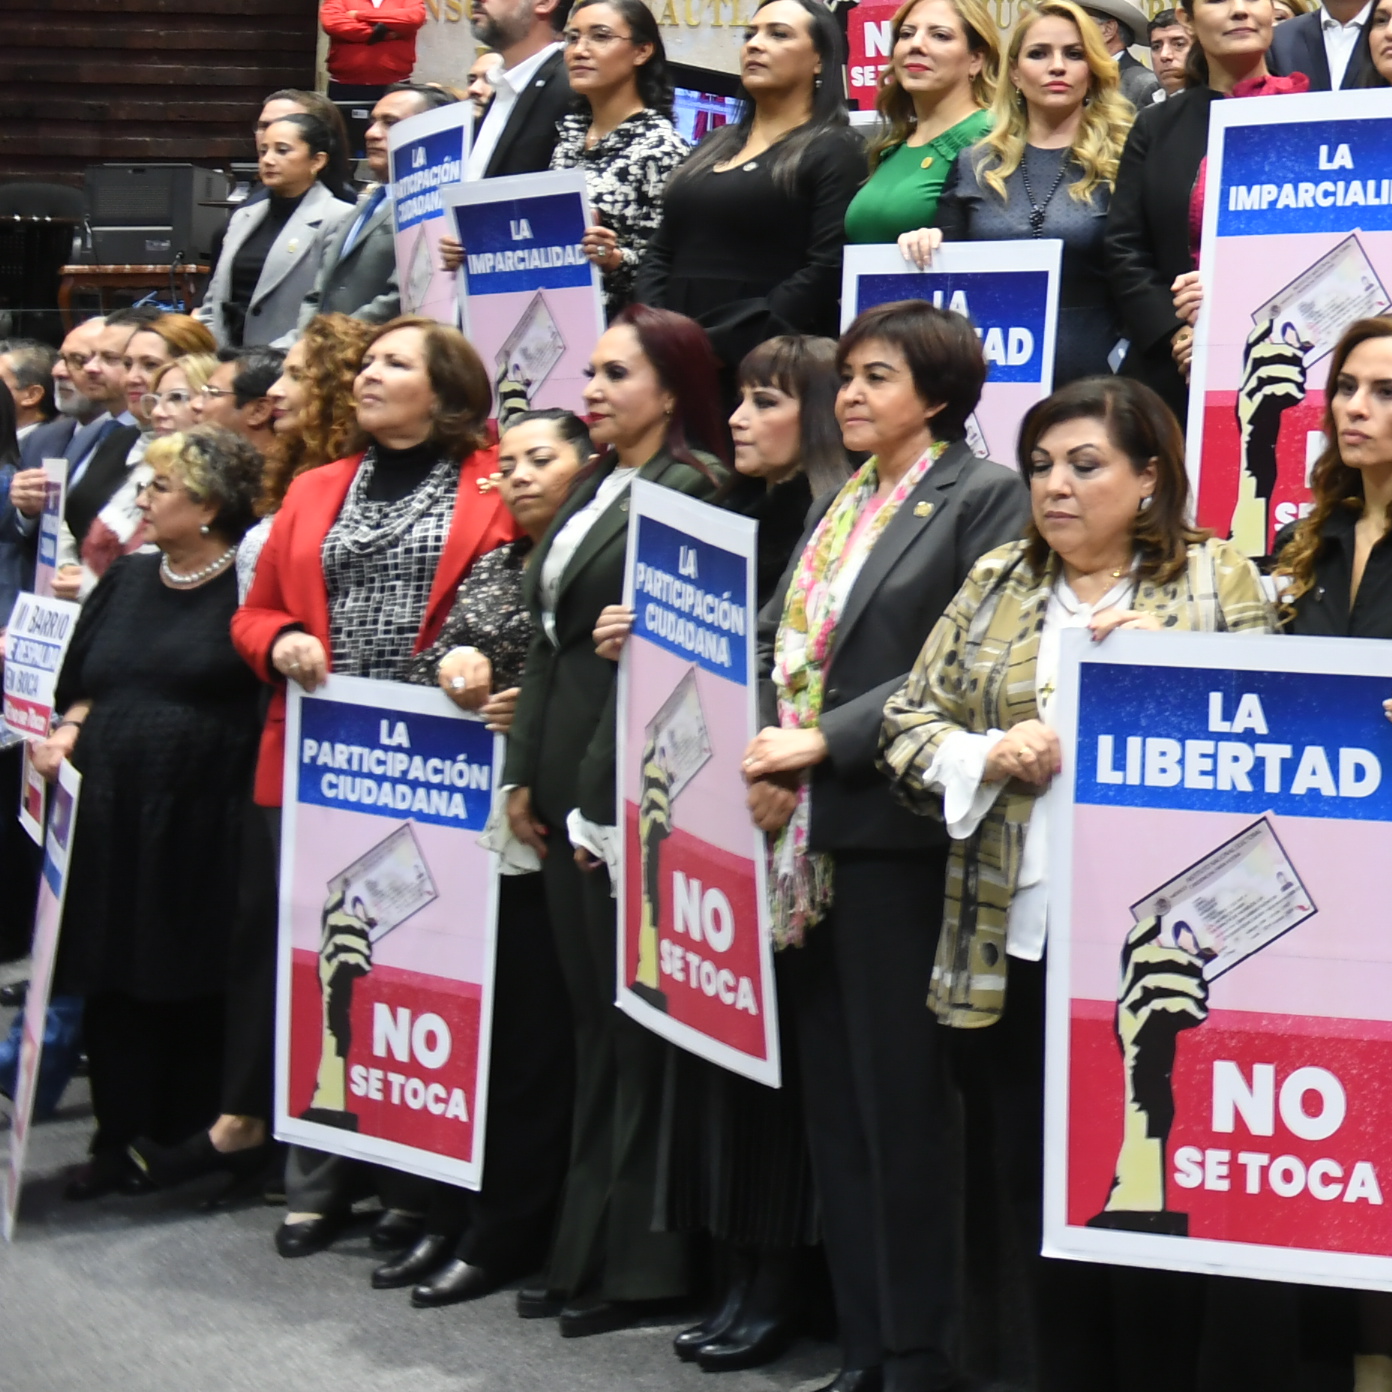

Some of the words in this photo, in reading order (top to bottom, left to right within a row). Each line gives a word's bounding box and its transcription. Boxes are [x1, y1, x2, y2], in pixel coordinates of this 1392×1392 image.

[1319, 144, 1353, 170] LA
[510, 219, 532, 240] LA
[468, 244, 587, 274] IMPARCIALIDAD
[679, 547, 697, 578] LA
[636, 562, 746, 637] PARTICIPACIÓN
[645, 602, 731, 668] CIUDADANA
[380, 720, 409, 747] LA
[1209, 692, 1268, 734] LA
[303, 739, 489, 791] PARTICIPACIÓN
[1097, 735, 1381, 797] LIBERTAD
[321, 773, 468, 819] CIUDADANA
[1212, 1061, 1346, 1140] NO
[1174, 1146, 1230, 1191] SE
[1238, 1152, 1382, 1204] TOCA
